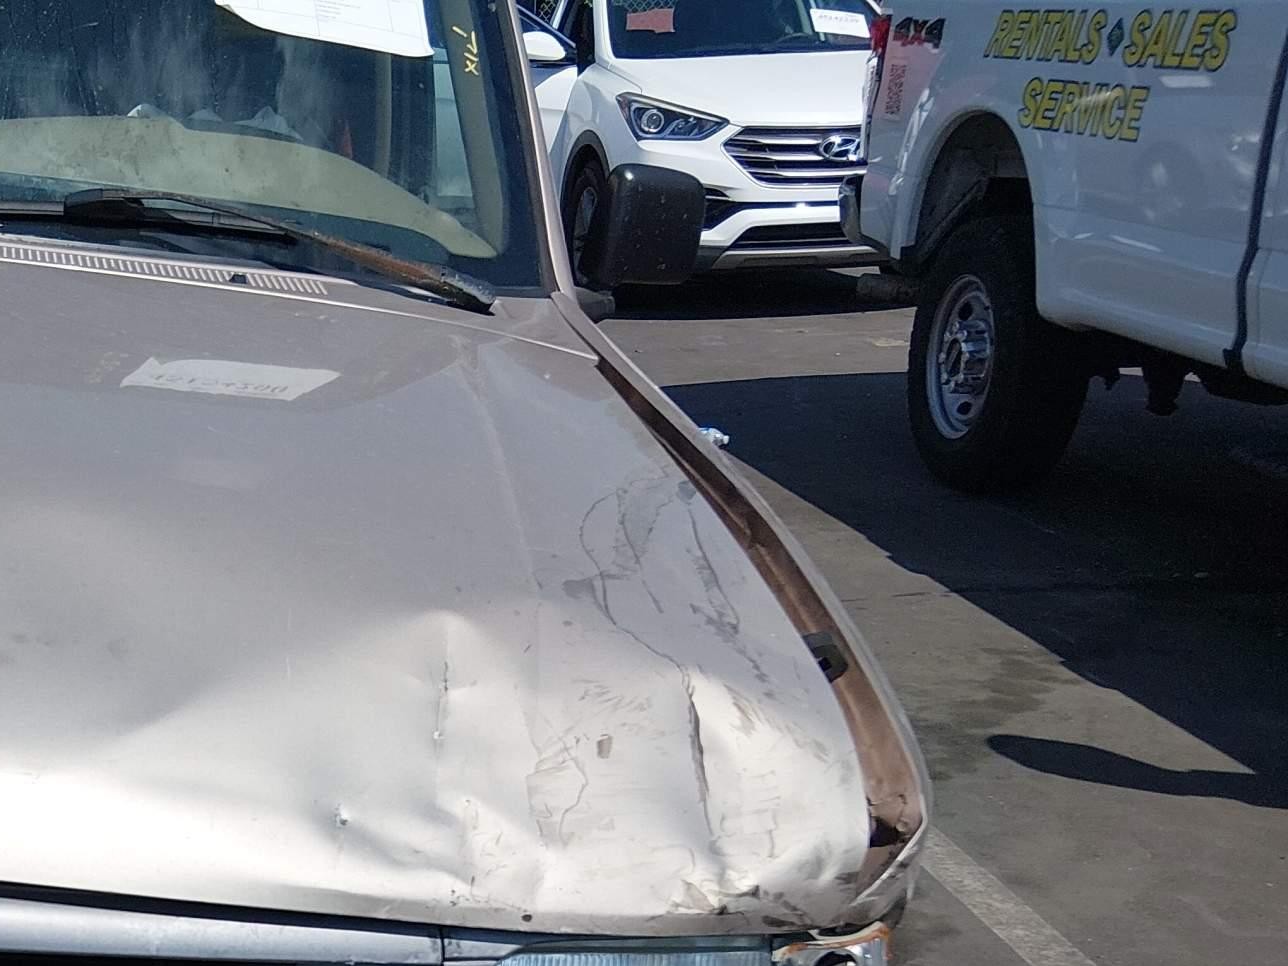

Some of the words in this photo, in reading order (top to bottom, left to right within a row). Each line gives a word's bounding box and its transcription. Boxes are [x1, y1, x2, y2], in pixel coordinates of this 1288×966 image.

[983, 9, 1108, 64] RENTALS
[1122, 8, 1238, 72] SALES
[1017, 77, 1150, 143] SERVICE
